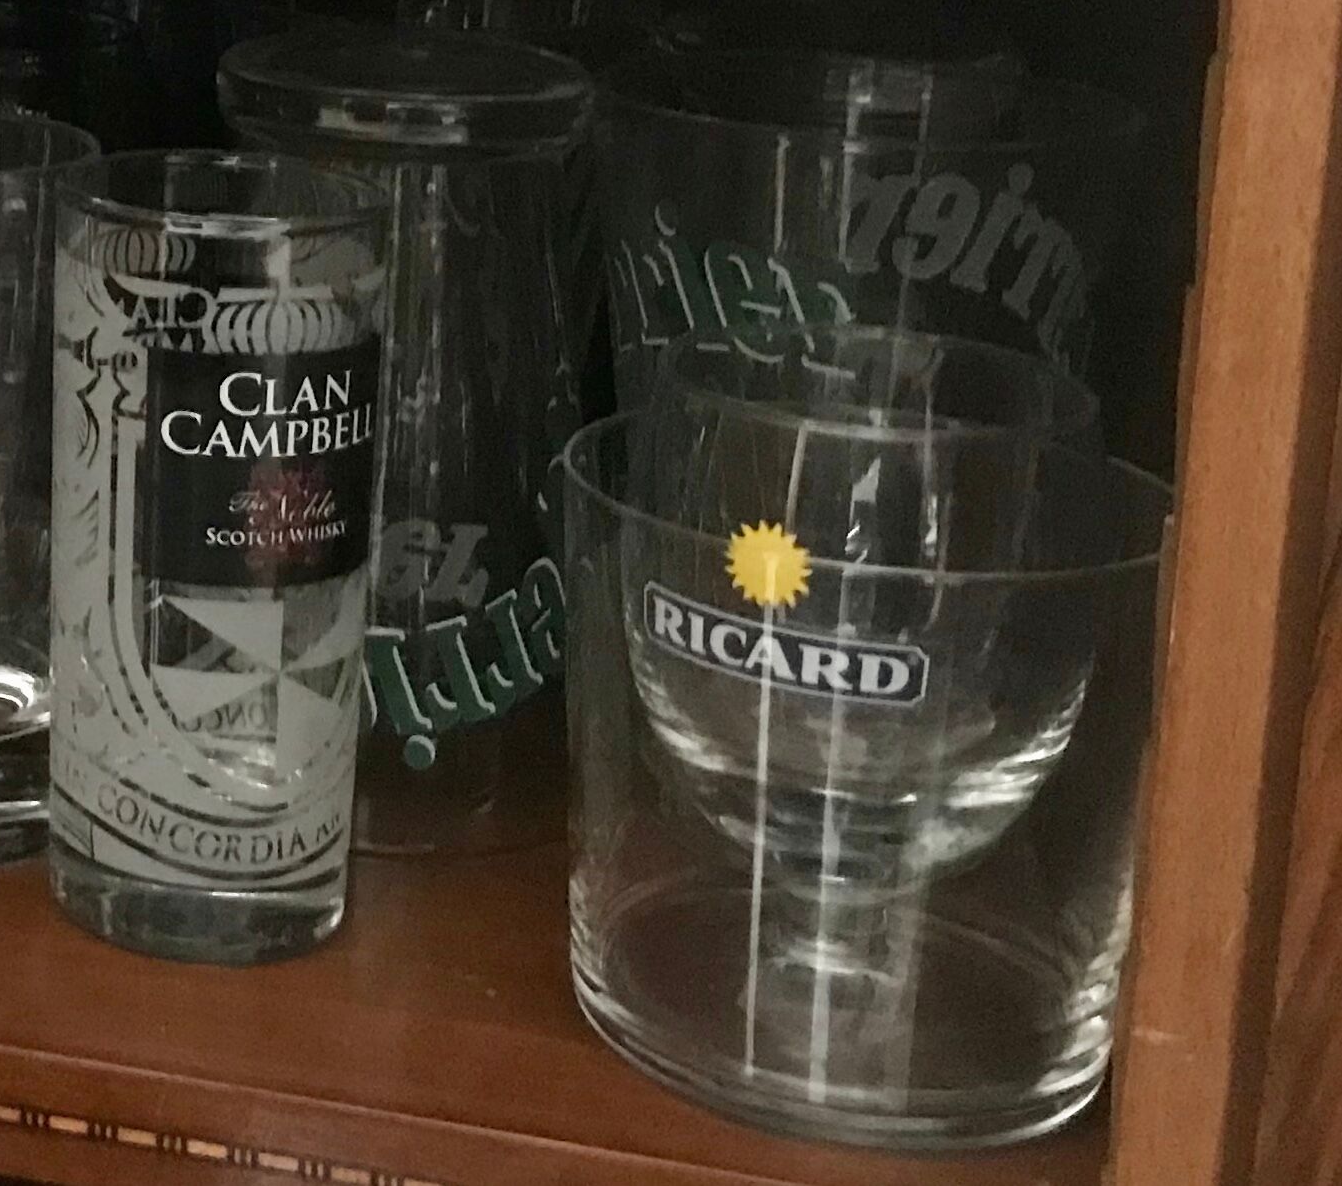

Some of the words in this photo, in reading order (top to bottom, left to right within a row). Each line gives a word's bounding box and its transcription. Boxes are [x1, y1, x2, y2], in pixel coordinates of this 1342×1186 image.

[219, 370, 352, 417] CLAN
[160, 402, 374, 459] CAMPBELL
[205, 527, 284, 547] SCOTCH
[651, 595, 913, 697] RICARD
[97, 783, 307, 864] CONCORDIA
